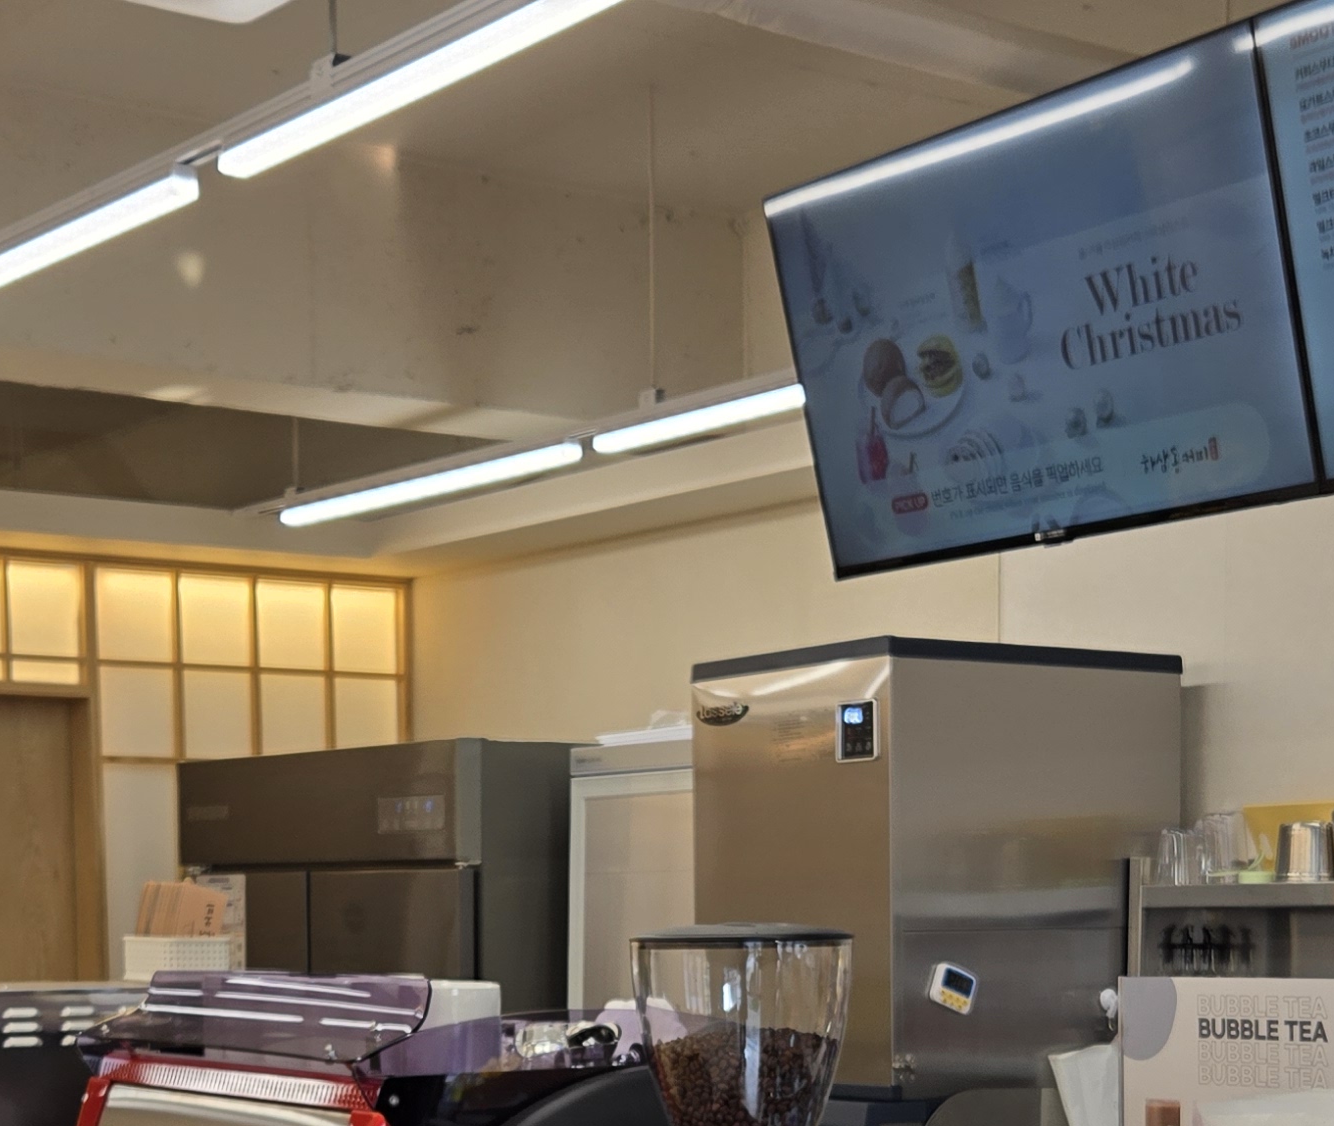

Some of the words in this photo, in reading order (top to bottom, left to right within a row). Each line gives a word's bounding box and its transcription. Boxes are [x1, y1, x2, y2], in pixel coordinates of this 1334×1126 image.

[1083, 255, 1200, 317] White
[1059, 299, 1244, 371] Christmas
[1197, 995, 1279, 1019] BUBBLE
[1284, 996, 1328, 1020] TEA
[1197, 1018, 1279, 1042] BUBBLE
[1284, 1019, 1328, 1043] TEA
[1197, 1042, 1279, 1066] BUBBLE
[1284, 1043, 1328, 1067] TEA
[1197, 1065, 1279, 1089] BUBBLE
[1284, 1066, 1328, 1090] TEA
